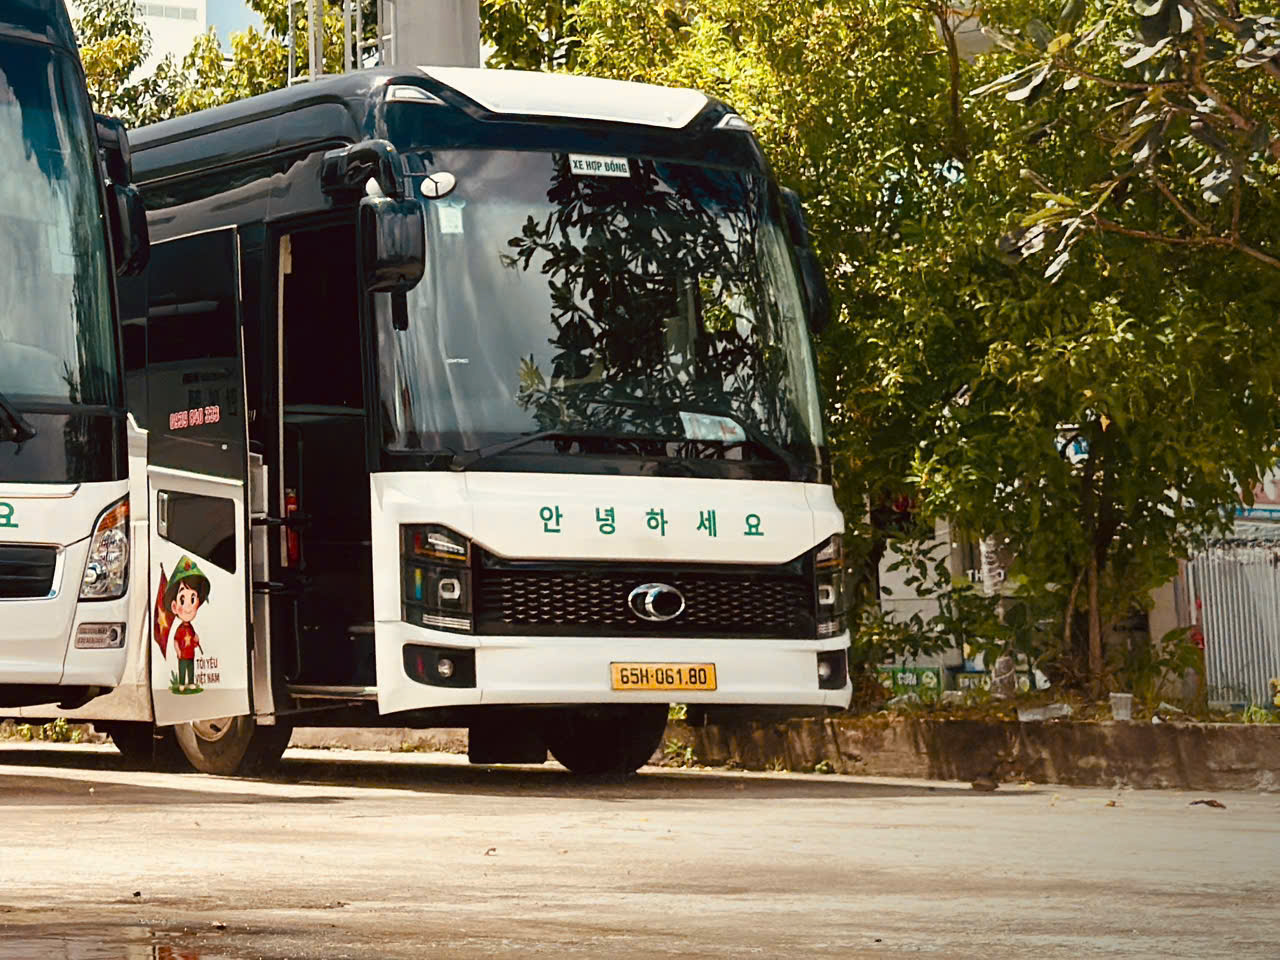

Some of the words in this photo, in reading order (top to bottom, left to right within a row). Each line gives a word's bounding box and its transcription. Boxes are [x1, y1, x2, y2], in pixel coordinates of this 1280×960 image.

[572, 160, 584, 169] XE
[539, 505, 765, 538] 안녕하세요
[620, 668, 707, 685] 65H-061.80
